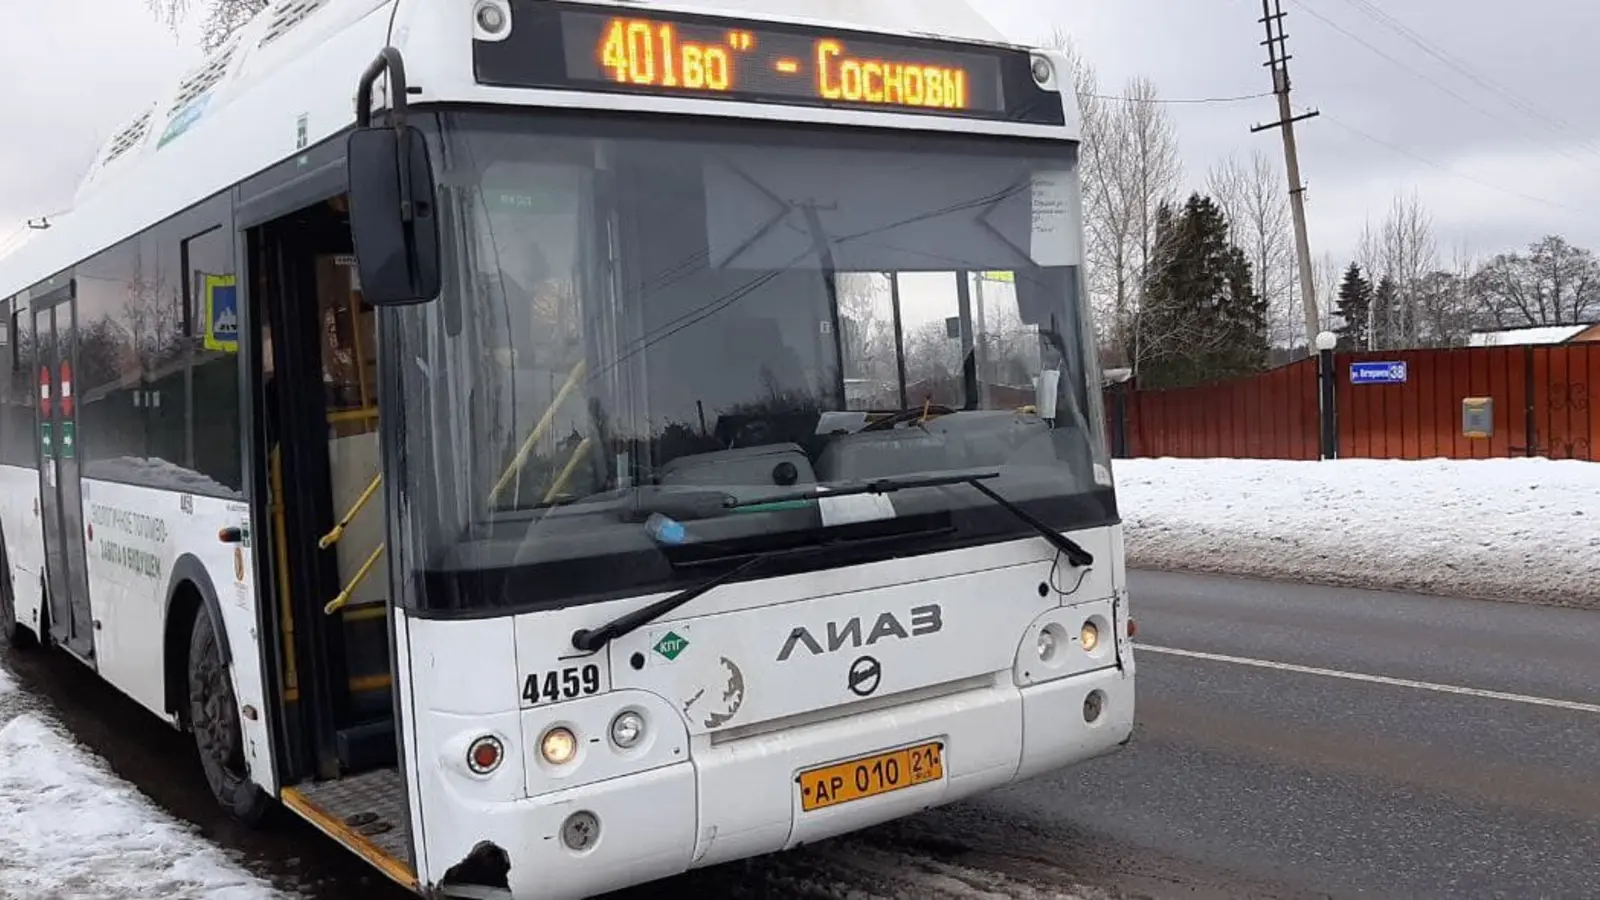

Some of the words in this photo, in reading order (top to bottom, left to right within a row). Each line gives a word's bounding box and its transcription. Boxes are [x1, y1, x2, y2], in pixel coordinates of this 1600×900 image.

[660, 638, 683, 653] КПГ
[776, 603, 943, 661] ЛИАЗ
[522, 663, 600, 704] 4459
[855, 757, 899, 793] 010
[912, 748, 933, 772] 21
